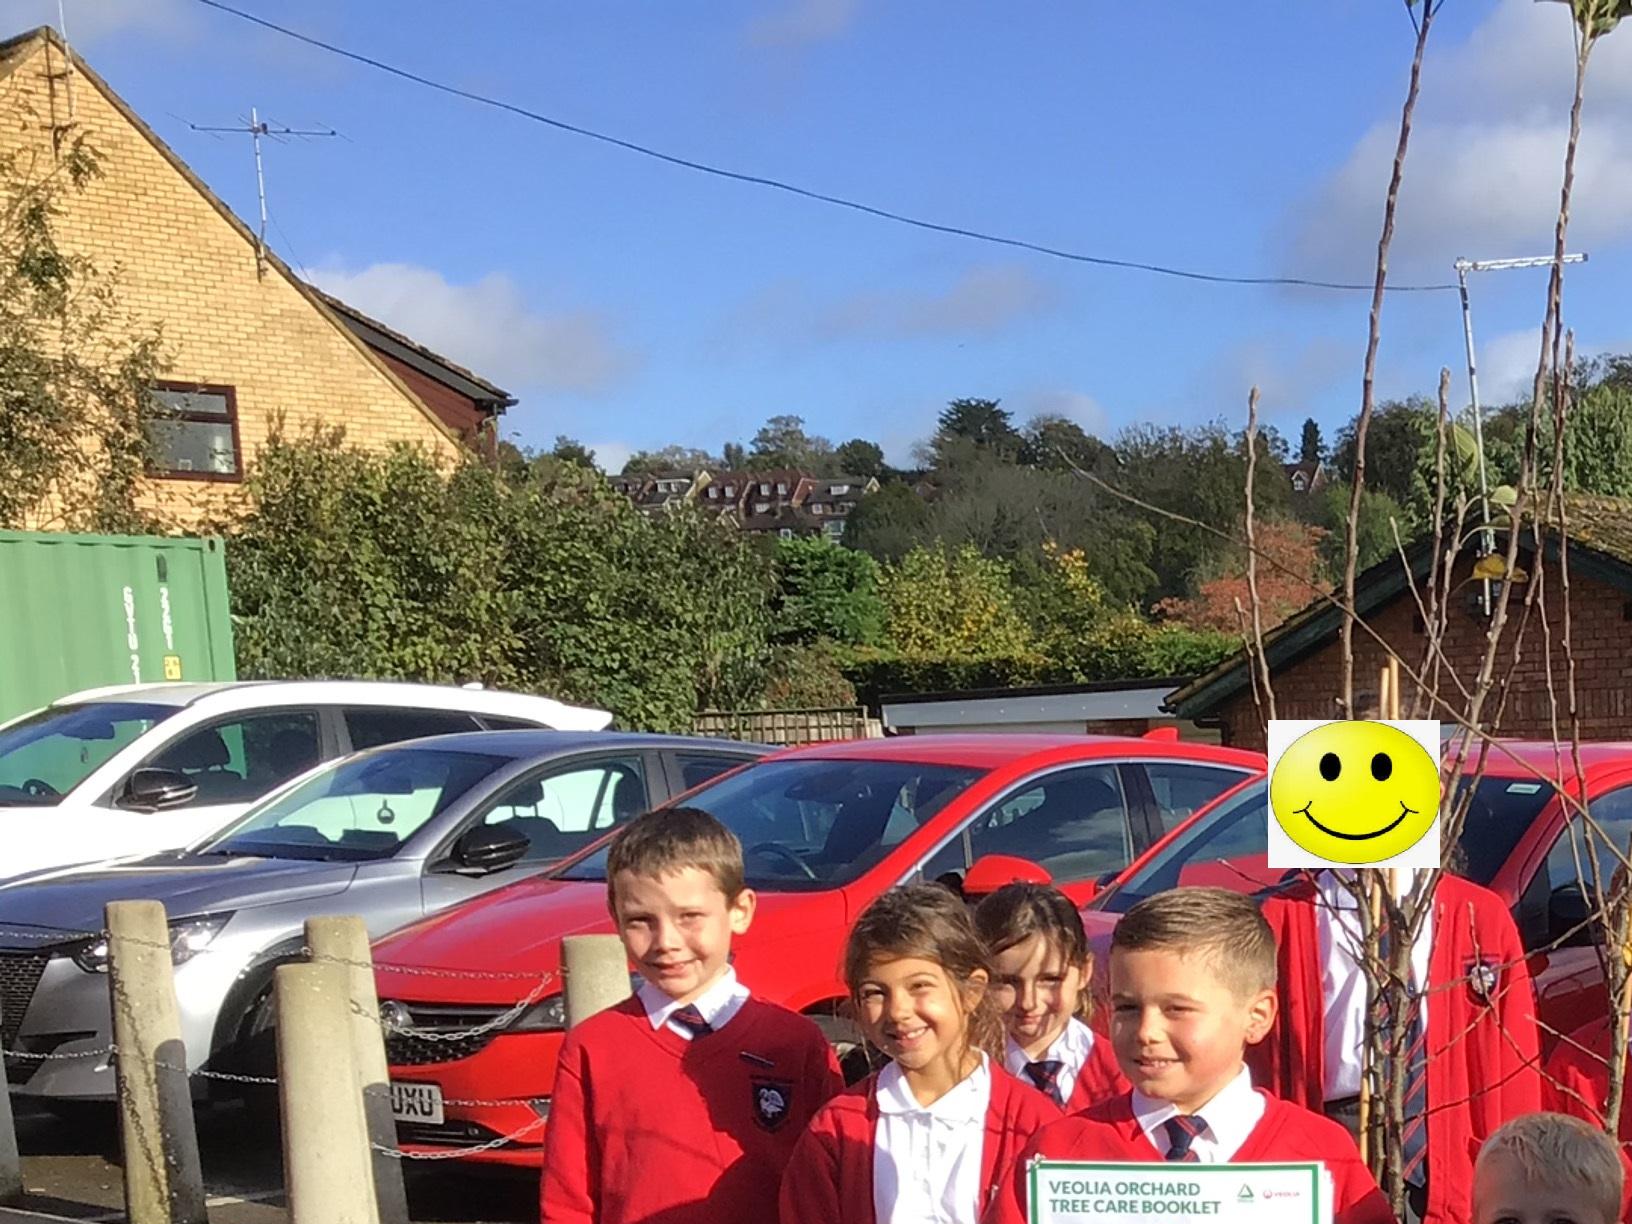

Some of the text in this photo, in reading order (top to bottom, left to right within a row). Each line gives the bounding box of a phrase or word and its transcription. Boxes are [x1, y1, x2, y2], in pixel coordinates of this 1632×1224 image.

[1049, 1181, 1200, 1196] VEOLIA ORCHARD
[1050, 1199, 1221, 1214] TREE CARE BOOKLET
